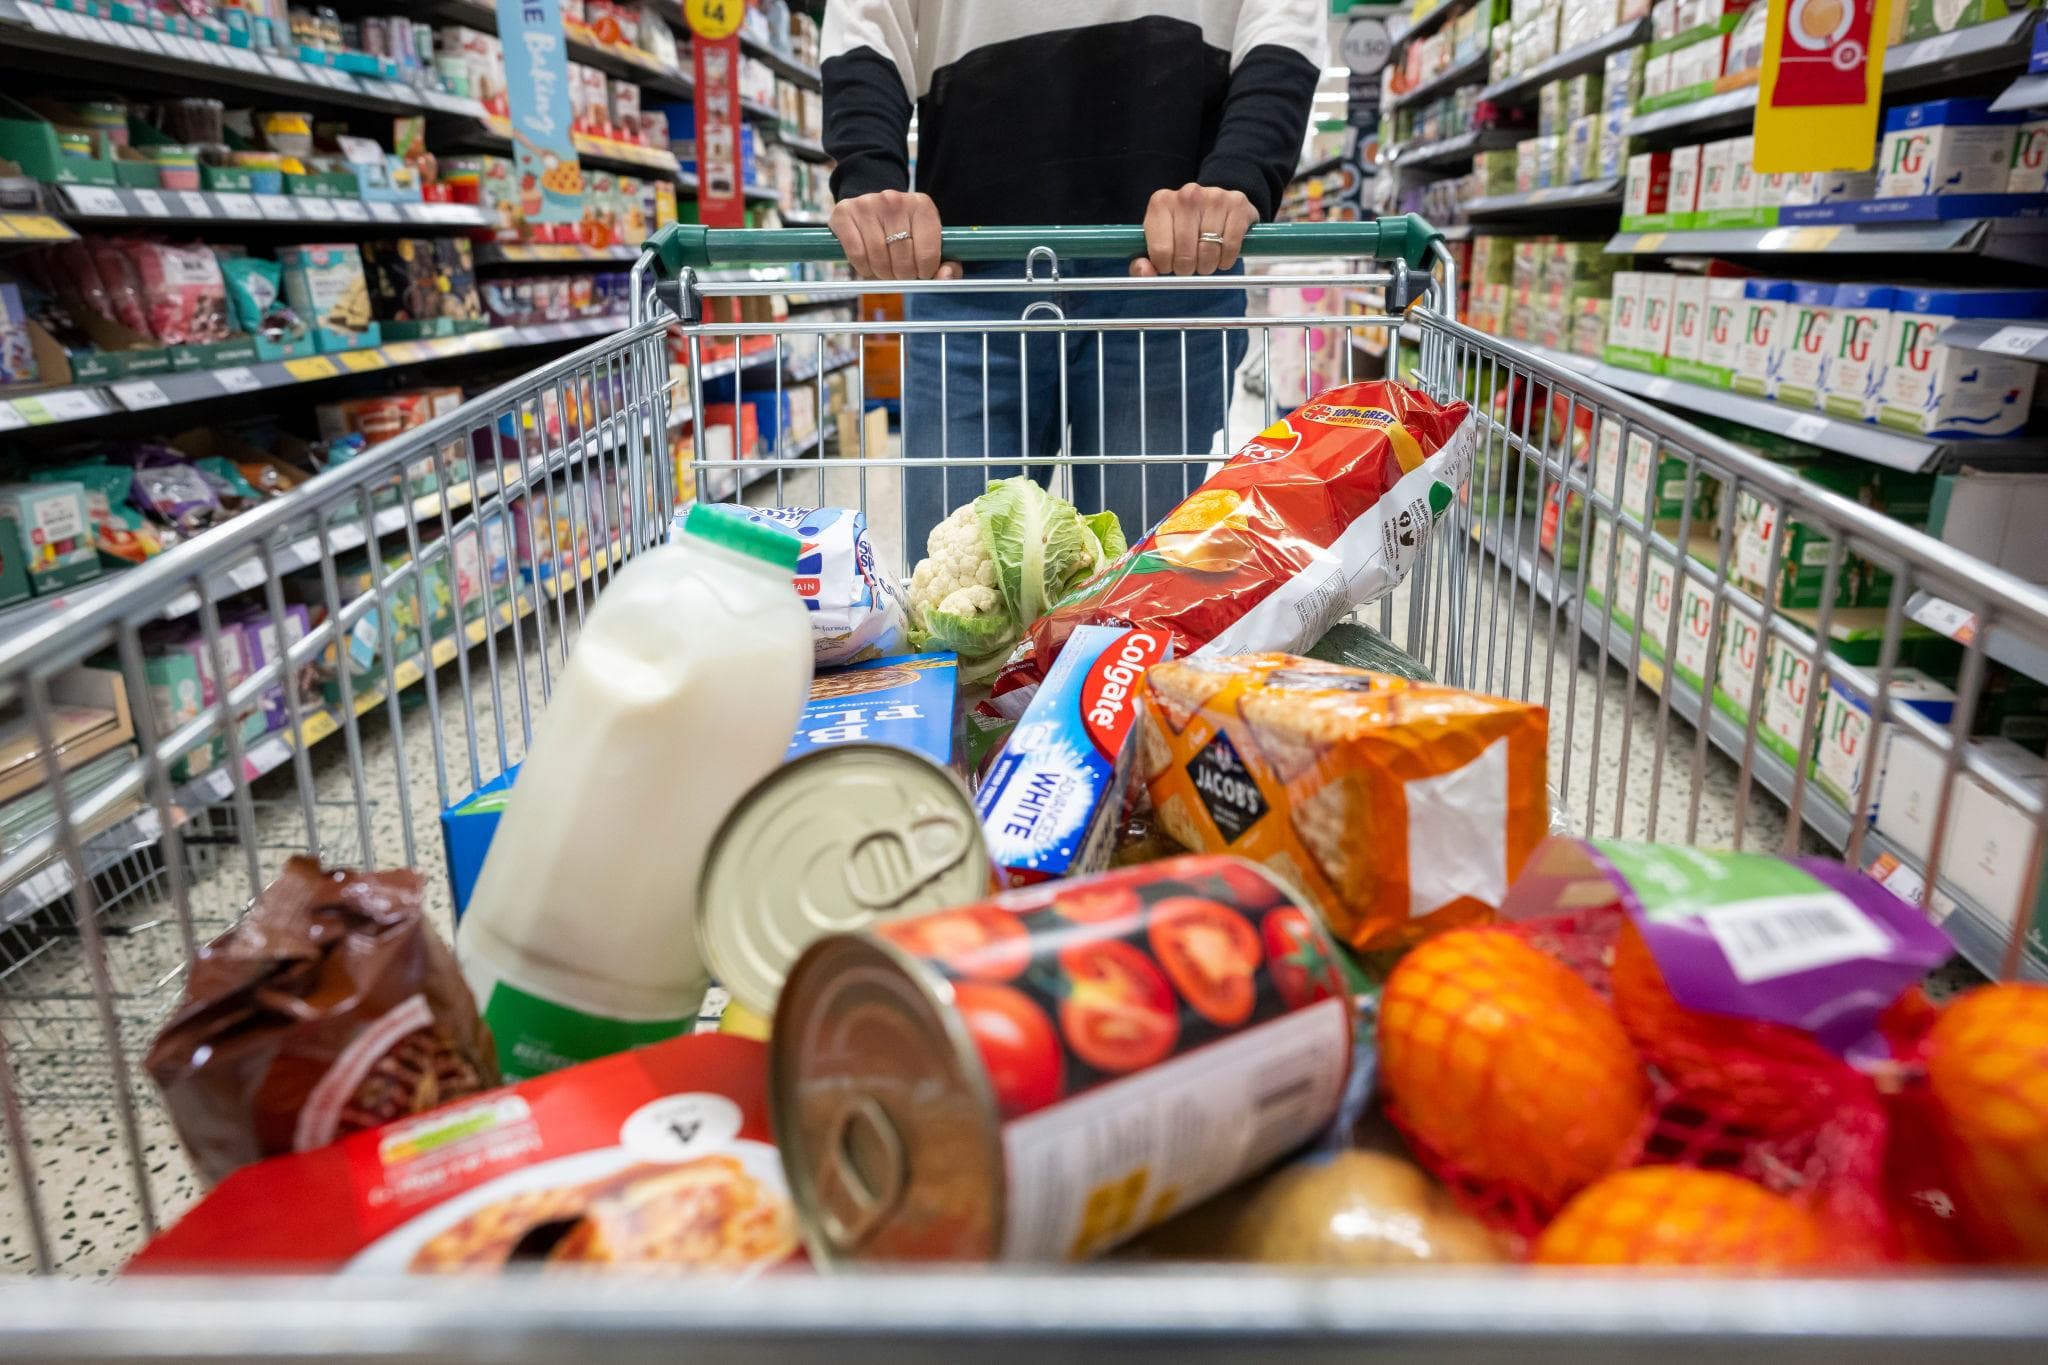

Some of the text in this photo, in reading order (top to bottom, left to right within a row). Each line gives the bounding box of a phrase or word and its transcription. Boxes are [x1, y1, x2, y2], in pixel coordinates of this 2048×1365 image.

[523, 32, 557, 135] Baking
[1891, 134, 1925, 175] PG
[1746, 305, 1773, 347] PG
[1793, 310, 1830, 354] PG
[1839, 315, 1873, 363] PG
[1895, 320, 1935, 372] PG
[1332, 408, 1397, 424] 100% GREAT
[1352, 417, 1389, 429] POTATOES
[1685, 591, 1710, 639] PG
[1731, 619, 1757, 671] PG
[1088, 633, 1157, 729] Colgate
[1776, 649, 1809, 705] PG
[1830, 701, 1860, 756] PG
[1004, 772, 1061, 840] WHITE
[1195, 764, 1259, 815] JACOB'S
